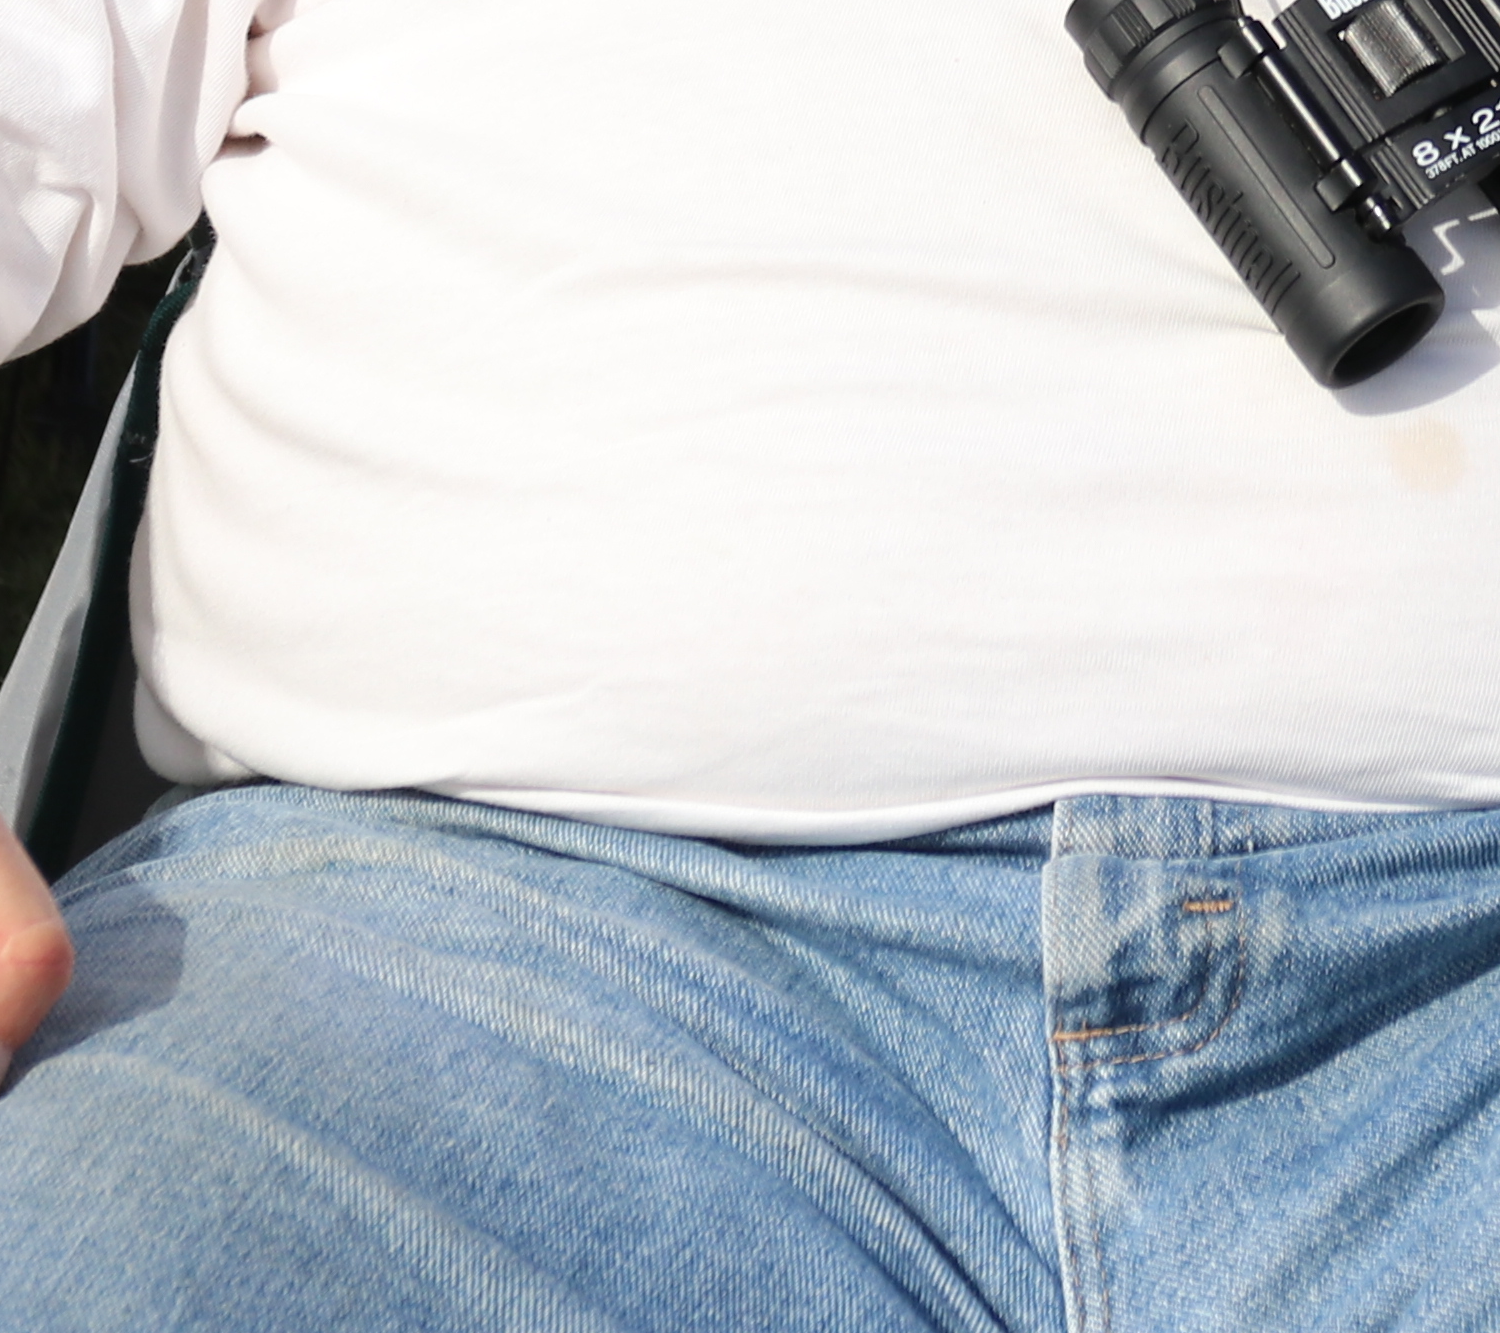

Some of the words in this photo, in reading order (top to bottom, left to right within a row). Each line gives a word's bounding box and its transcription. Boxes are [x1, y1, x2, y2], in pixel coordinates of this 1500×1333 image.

[1412, 140, 1440, 167] 8
[1443, 125, 1471, 151] x
[1461, 143, 1476, 160] AT
